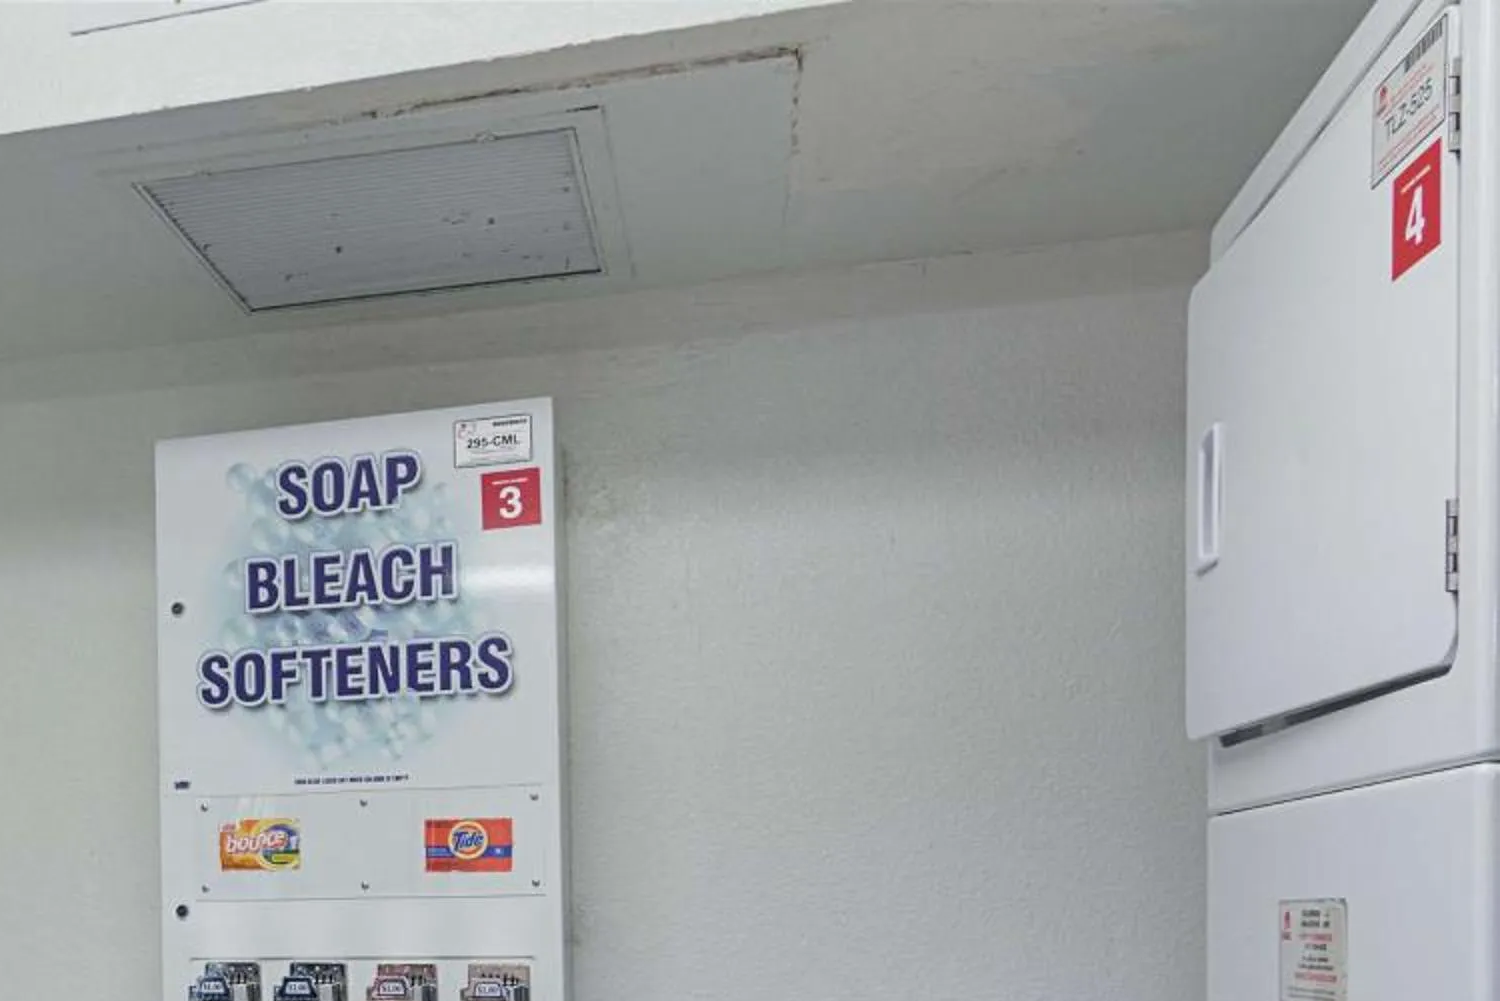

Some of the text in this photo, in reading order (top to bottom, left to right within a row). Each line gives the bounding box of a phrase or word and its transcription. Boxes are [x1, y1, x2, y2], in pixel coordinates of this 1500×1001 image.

[1404, 184, 1426, 246] 4
[467, 433, 520, 449] 295-CML
[275, 453, 420, 517] SOAP
[499, 485, 523, 519] 3
[245, 543, 456, 611] BLEACH
[199, 635, 513, 706] SOFTENERS
[452, 830, 484, 851] Tide
